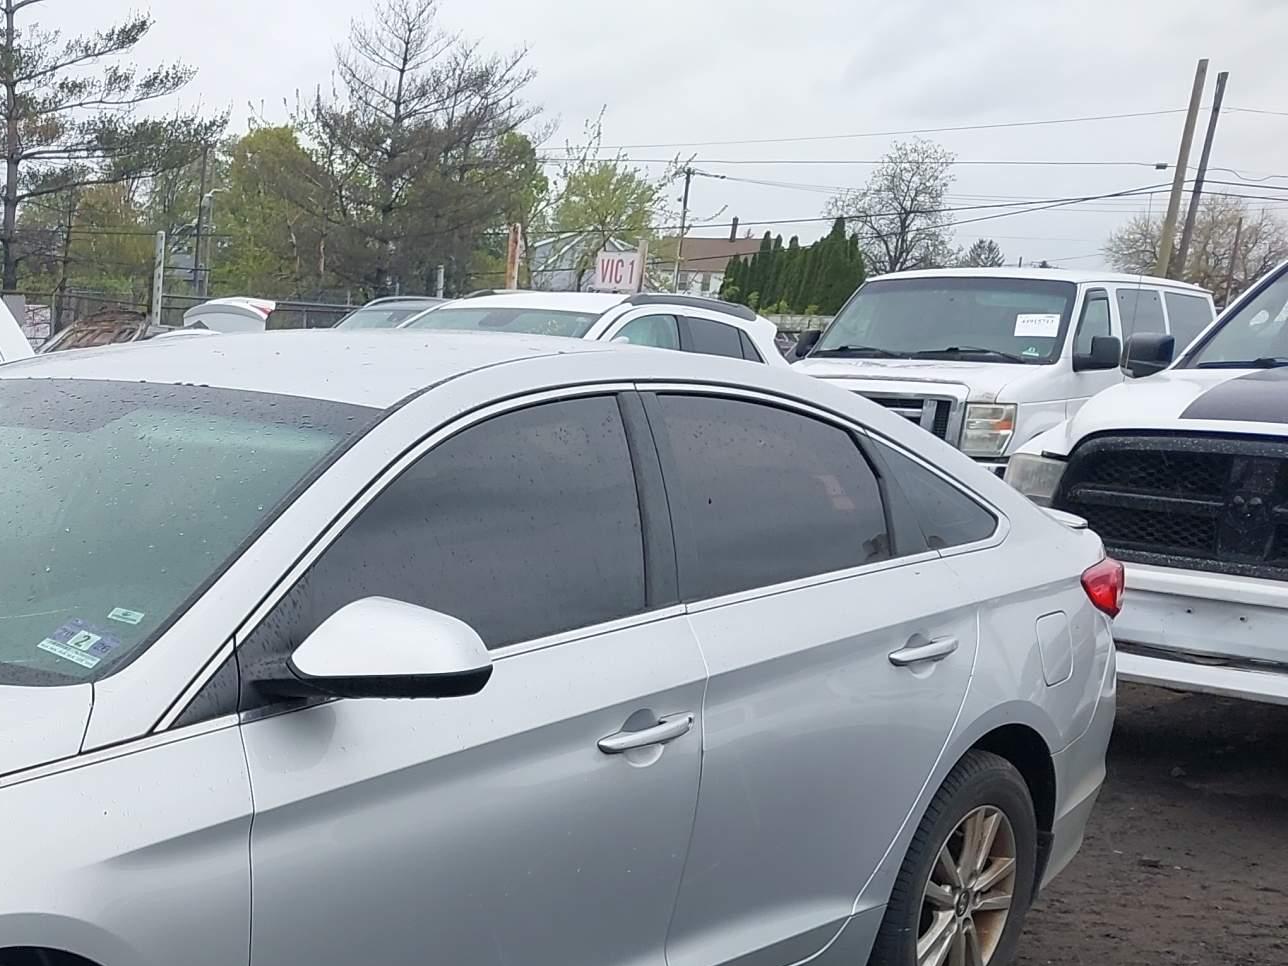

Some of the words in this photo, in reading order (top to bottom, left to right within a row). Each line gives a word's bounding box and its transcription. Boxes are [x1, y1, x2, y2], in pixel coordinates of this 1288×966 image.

[601, 258, 624, 284] VIC
[628, 259, 635, 285] 1
[73, 634, 91, 647] 2
